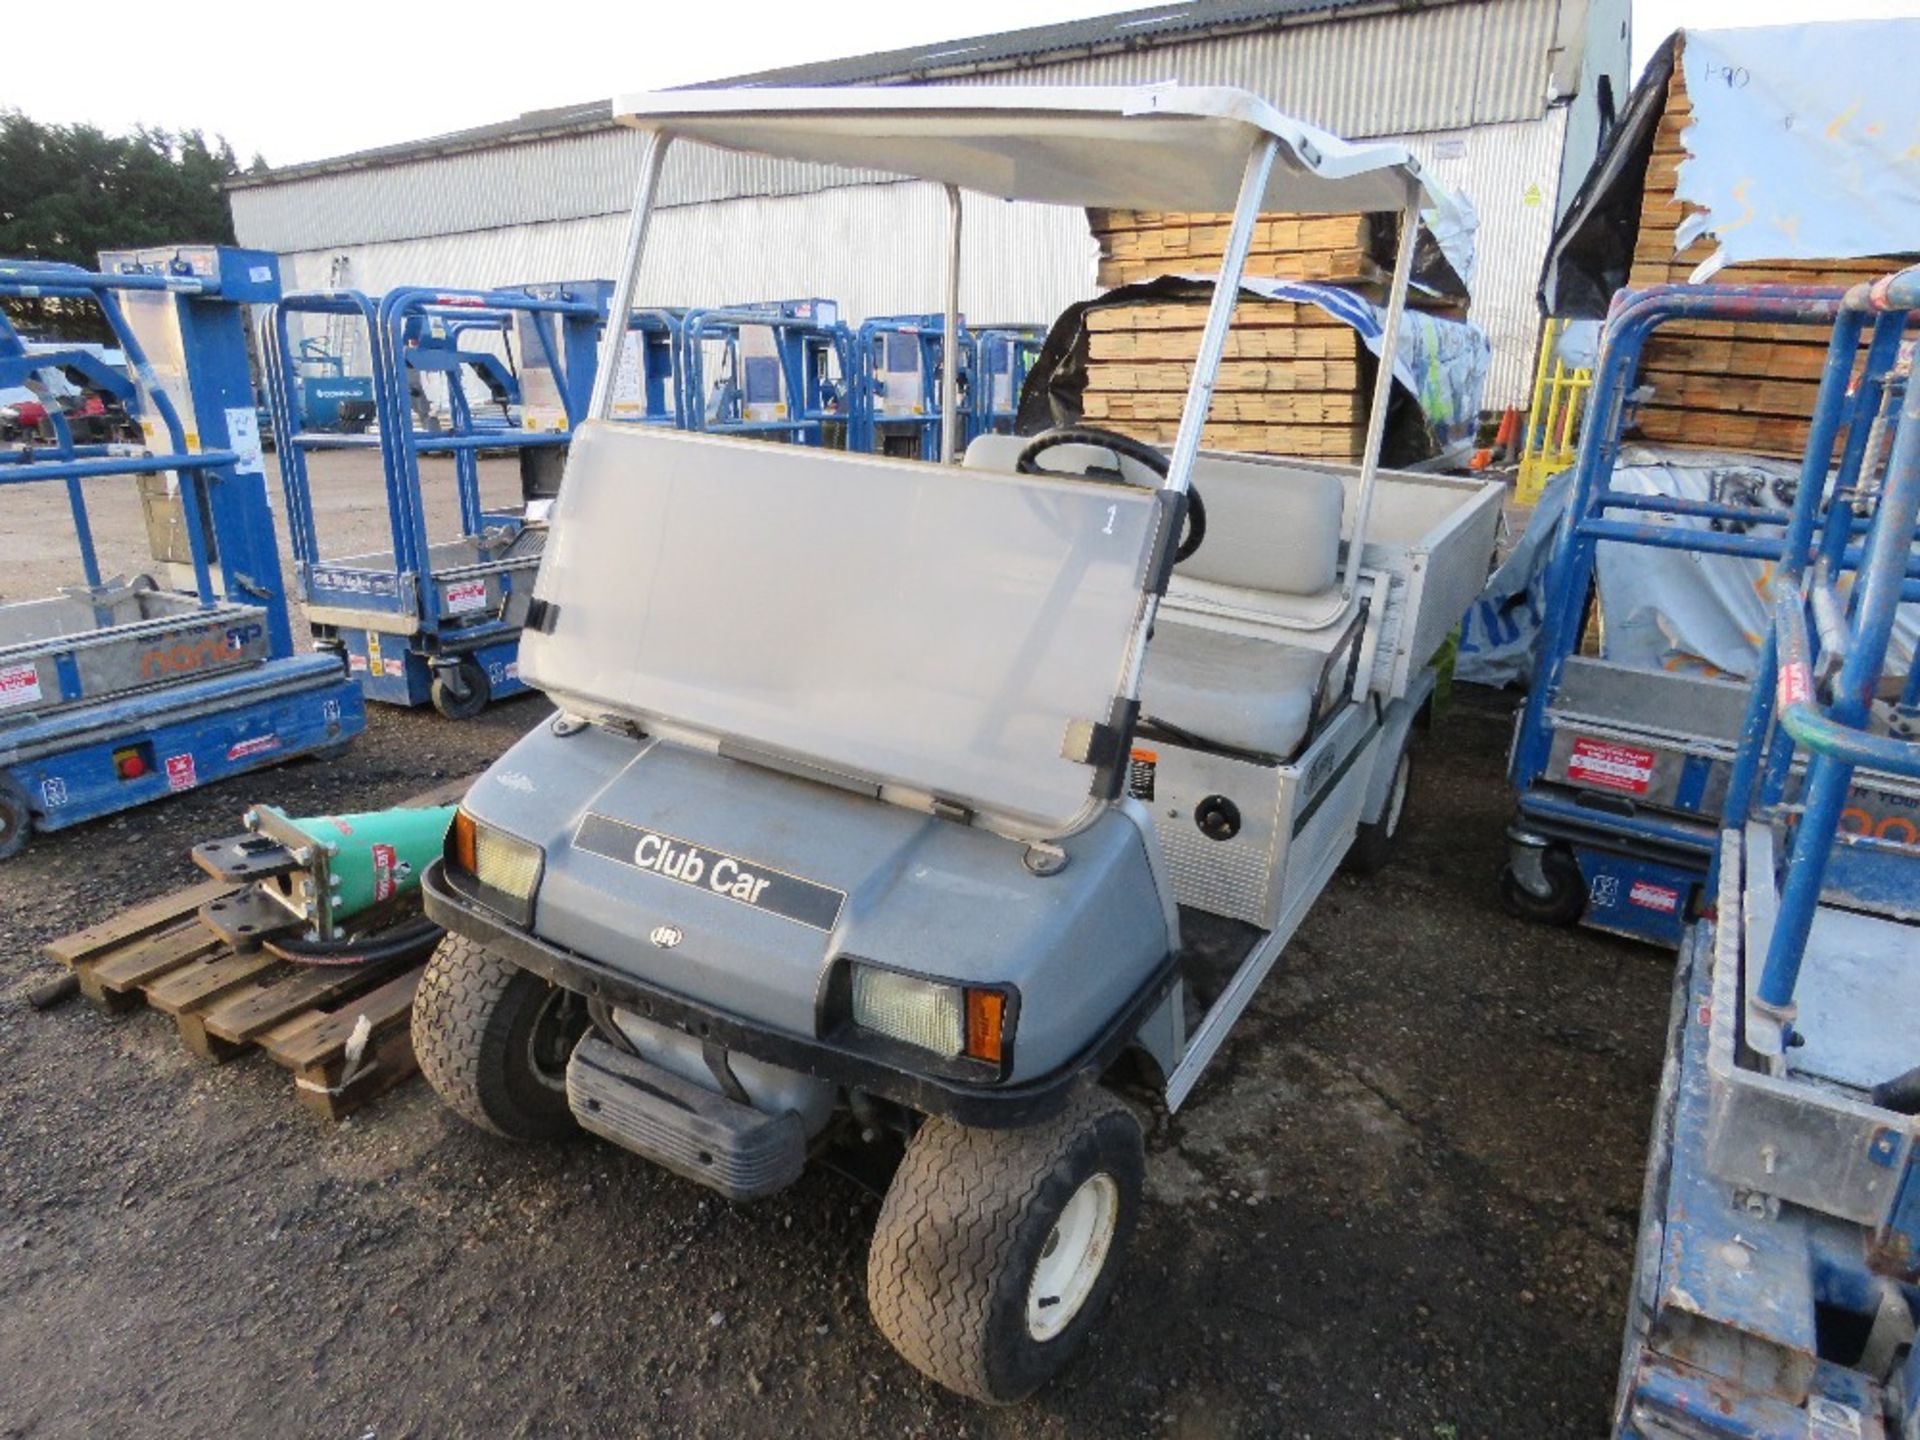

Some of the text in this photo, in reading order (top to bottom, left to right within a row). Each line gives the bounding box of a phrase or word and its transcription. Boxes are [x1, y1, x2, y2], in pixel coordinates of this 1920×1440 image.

[1151, 95, 1158, 108] 1
[634, 834, 771, 903] Club Car
